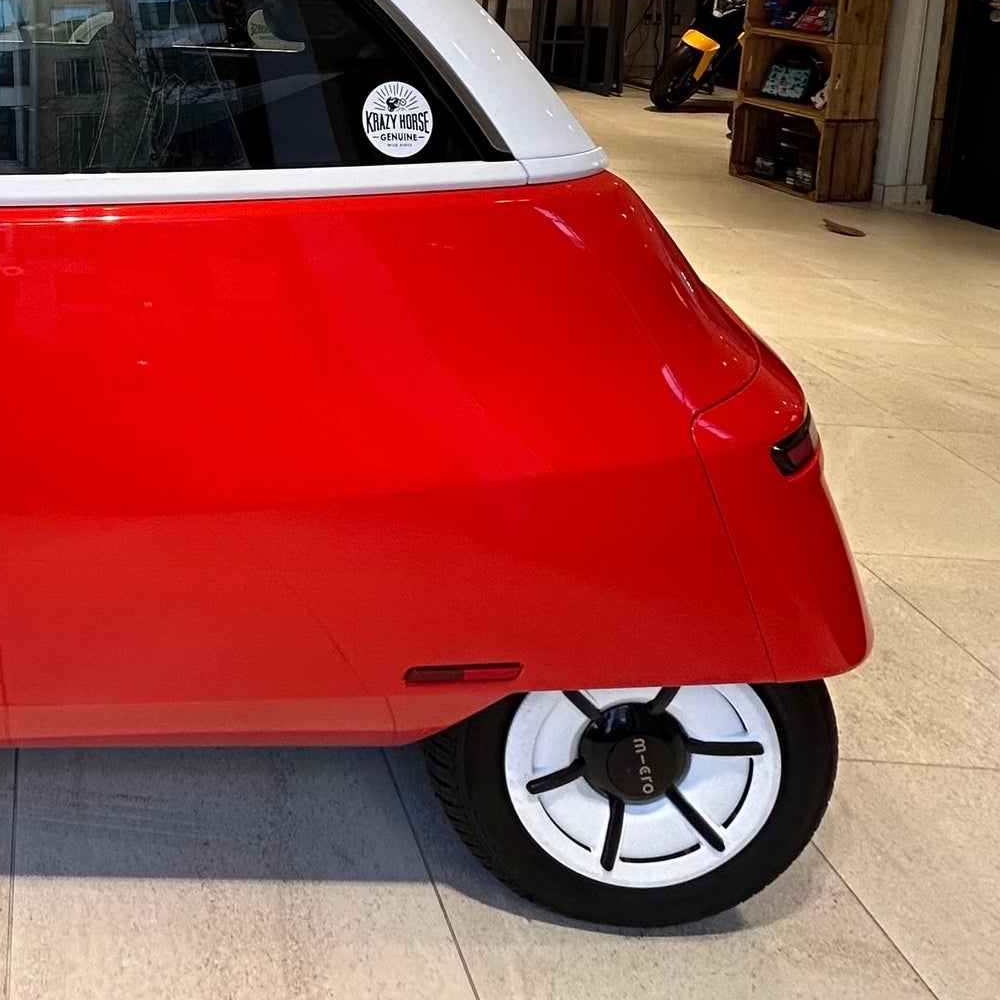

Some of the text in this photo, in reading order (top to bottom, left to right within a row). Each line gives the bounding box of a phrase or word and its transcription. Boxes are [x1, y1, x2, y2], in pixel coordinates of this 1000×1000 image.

[365, 110, 430, 134] KRAZY HORSE
[380, 133, 418, 141] GENUINE
